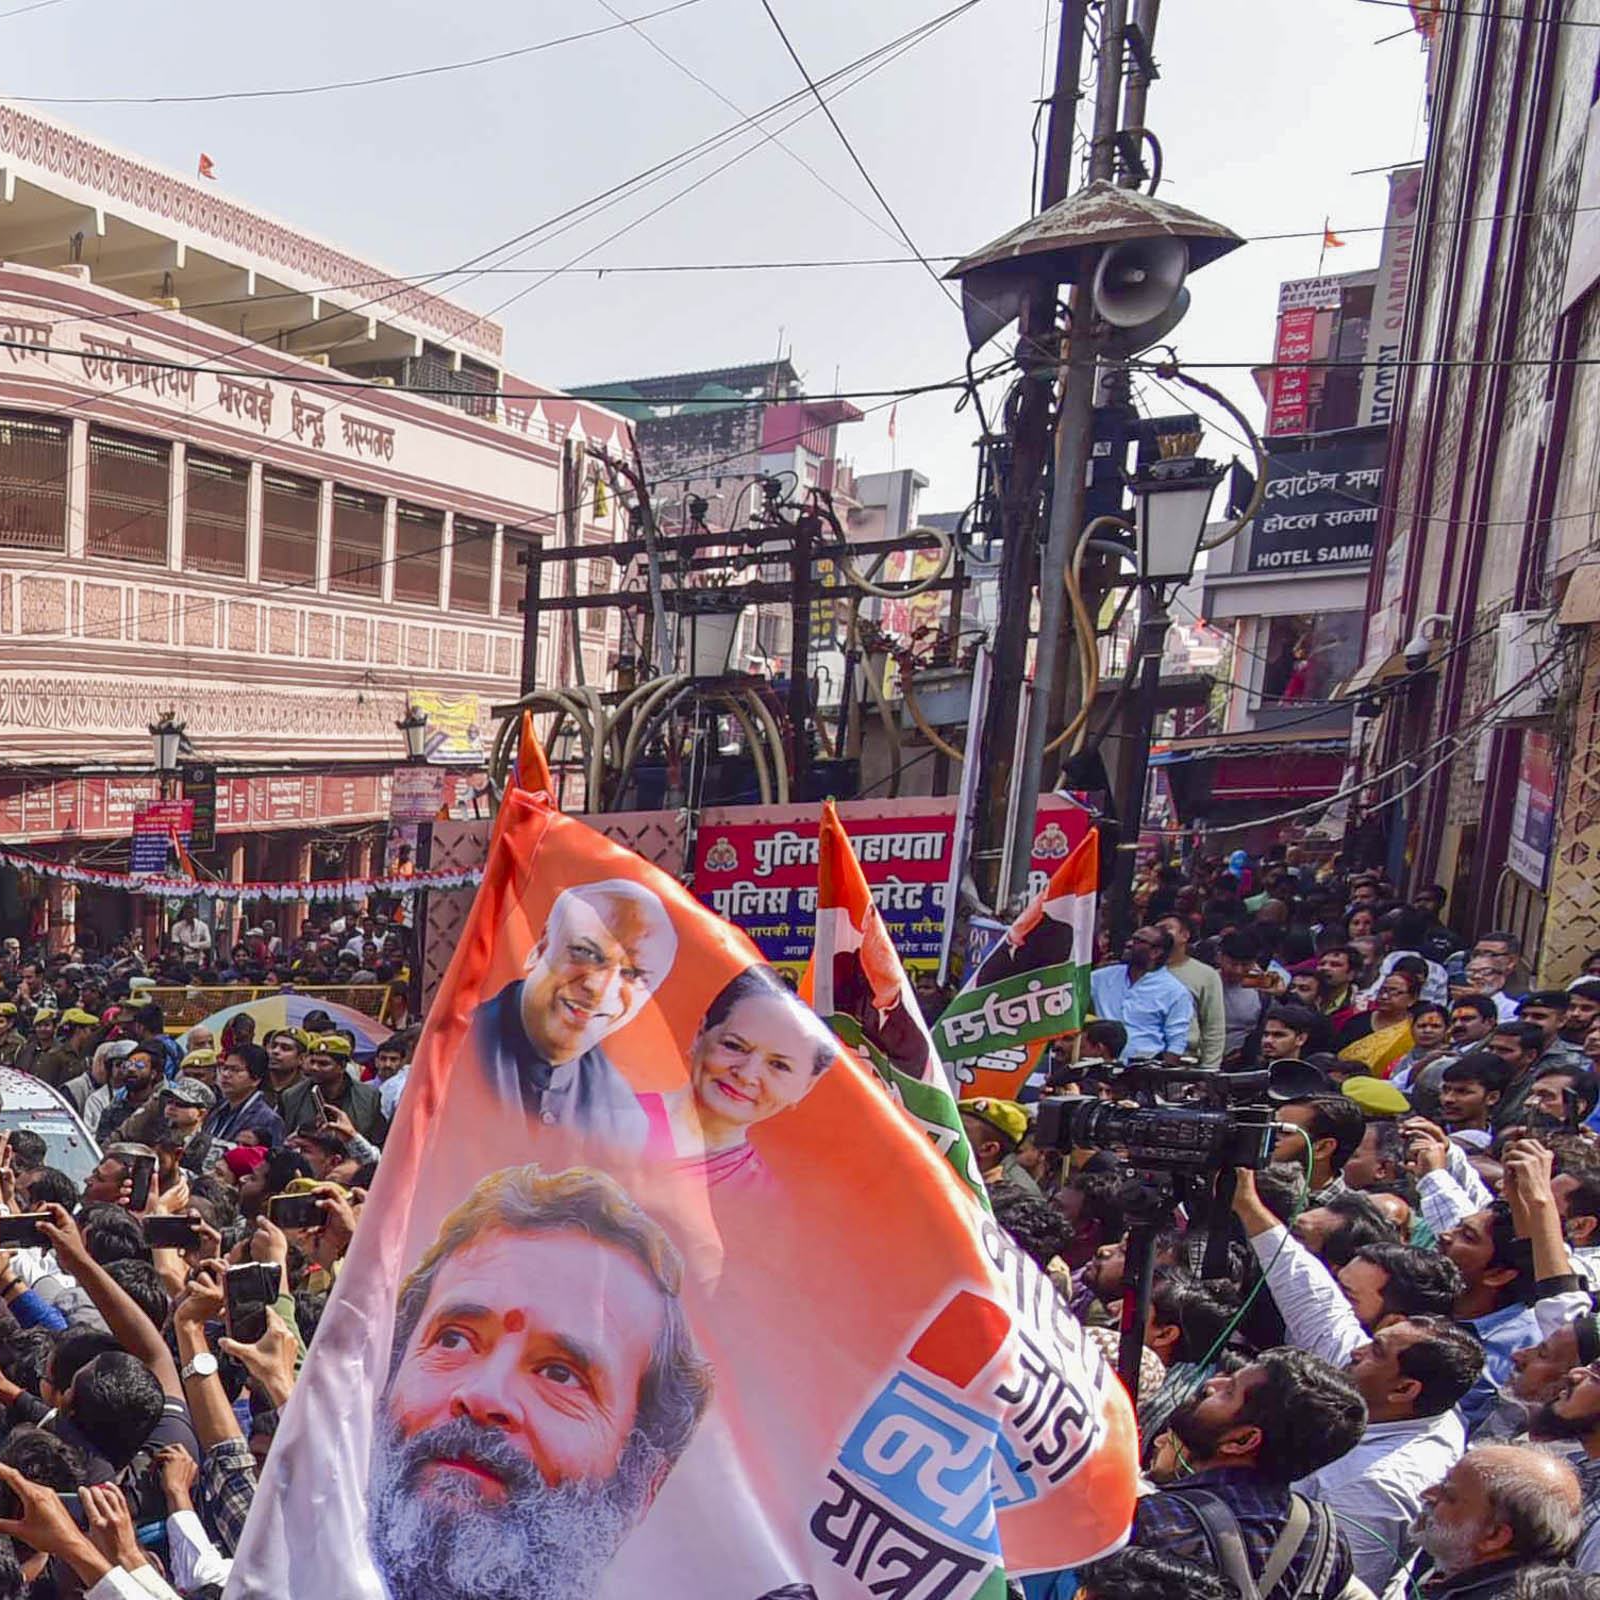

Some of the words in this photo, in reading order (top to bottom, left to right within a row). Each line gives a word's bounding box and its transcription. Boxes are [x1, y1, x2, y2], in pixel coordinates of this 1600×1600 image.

[1281, 287, 1341, 303] RESTAUR
[1262, 513, 1319, 534] होटल
[1325, 507, 1379, 529] सम्मा
[1257, 550, 1312, 568] HOTEL
[1316, 543, 1374, 563] SAMM
[852, 831, 946, 863] हायता
